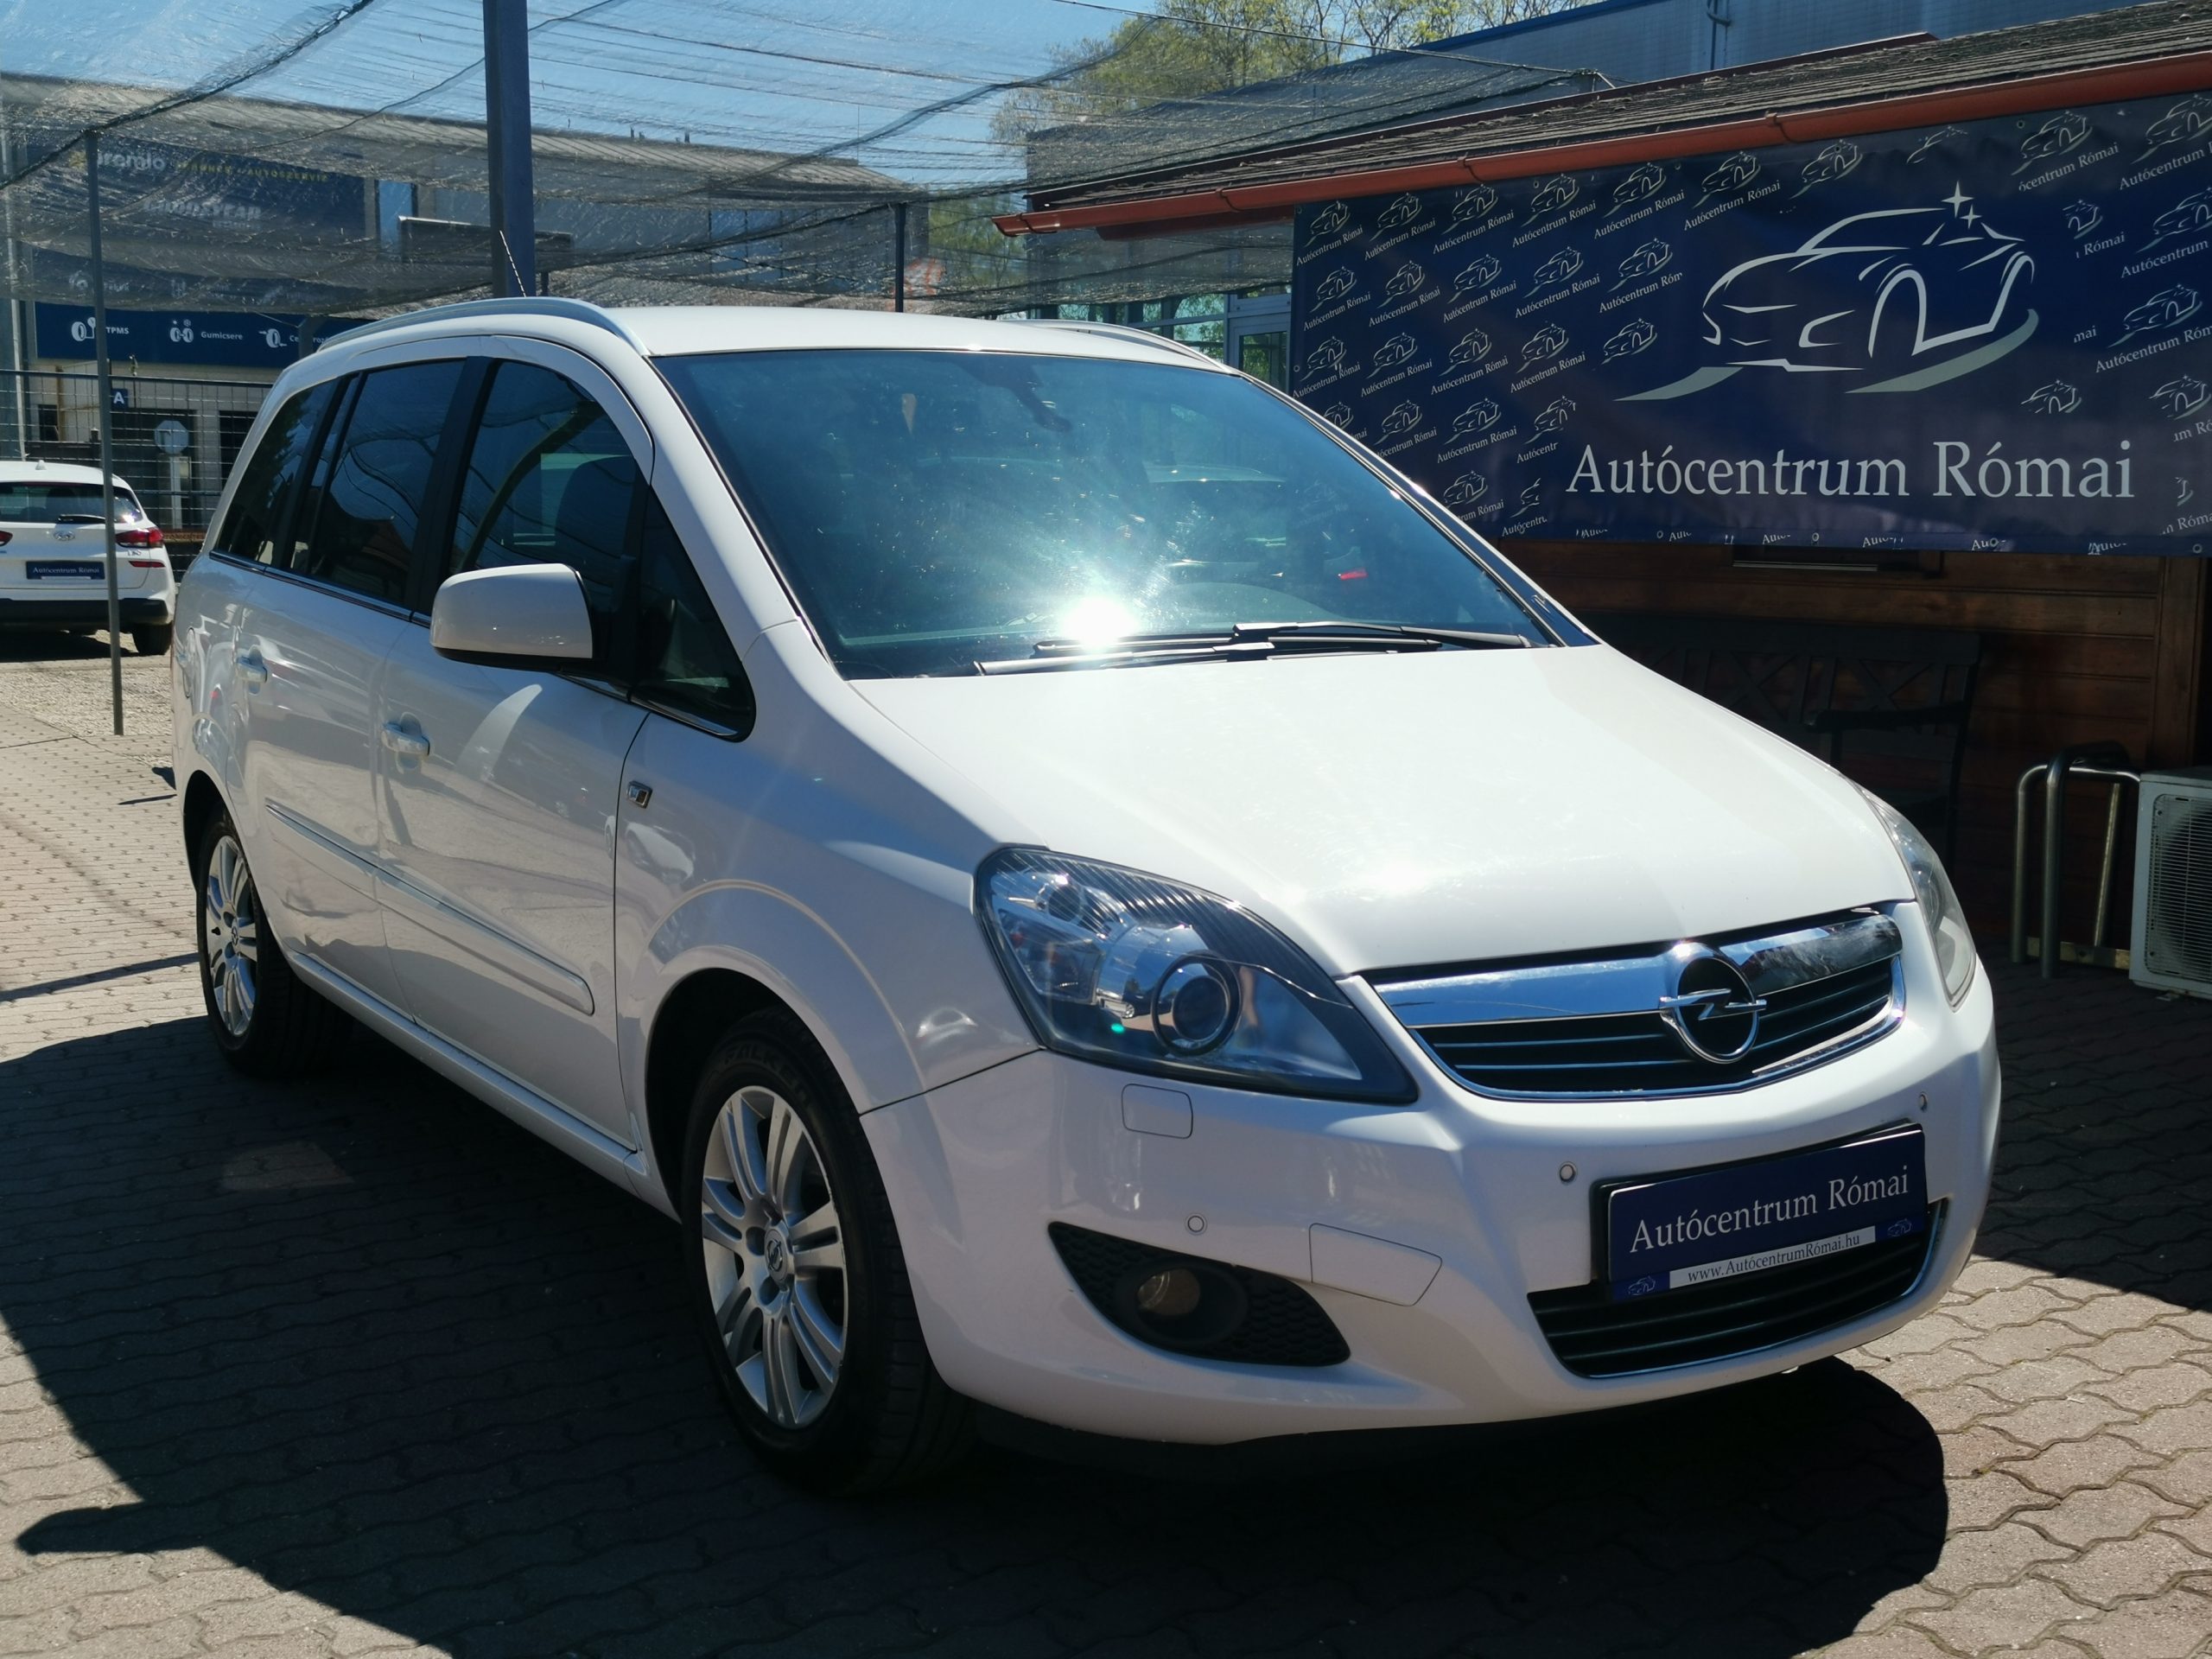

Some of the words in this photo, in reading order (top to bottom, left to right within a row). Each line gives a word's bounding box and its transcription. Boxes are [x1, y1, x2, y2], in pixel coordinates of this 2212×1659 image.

[2078, 143, 2119, 168] Római
[2120, 149, 2204, 190] Autócentrum
[1513, 217, 1567, 248] Autócentrum
[1569, 200, 1596, 220] Római
[1594, 207, 1652, 239] Autócentrum
[1655, 189, 1684, 211] Római
[1684, 198, 1744, 231] Autócentrum
[1748, 180, 1780, 201] Római
[1296, 238, 1342, 266] Autócentrum
[1343, 225, 1363, 243] Római
[1365, 232, 1408, 260] Autócentrum
[1411, 218, 1435, 236] Római
[1433, 226, 1485, 254] Autócentrum
[1488, 210, 1514, 229] Római
[2083, 231, 2126, 256] Római
[2121, 241, 2209, 278] Autócentrum
[1304, 305, 1345, 331] Autócentrum
[1347, 291, 1370, 308] Római
[1370, 301, 1418, 327] Autócentrum
[1419, 286, 1440, 304] Római
[1444, 296, 1488, 323] Autócentrum
[1491, 280, 1516, 299] Római
[1516, 289, 1569, 318] Autócentrum
[1572, 273, 1599, 293] Római
[1599, 283, 1658, 313] Autócentrum
[200, 330, 244, 341] Gumicsere
[2096, 338, 2180, 372] Autócentrum
[1293, 374, 1338, 399] Autócentrum
[1339, 362, 1360, 378] Római
[1362, 372, 1405, 397] Autócentrum
[1408, 359, 1432, 376] Római
[1431, 370, 1484, 395] Autócentrum
[1485, 355, 1508, 373] Római
[1511, 366, 1558, 393] Autócentrum
[1559, 352, 1586, 370] Római
[113, 391, 125, 404] A
[1414, 427, 1437, 443] Római
[1438, 439, 1488, 463] Autócentrum
[1491, 426, 1516, 442] Római
[1566, 444, 1910, 496] Autócentrum
[1932, 439, 2135, 498] Római
[1477, 499, 1504, 517] Római
[1630, 1192, 1816, 1253] Autócentrum
[1827, 1165, 1909, 1211] Római
[1688, 1234, 1859, 1282] www.AutócentrumRómai.hu
